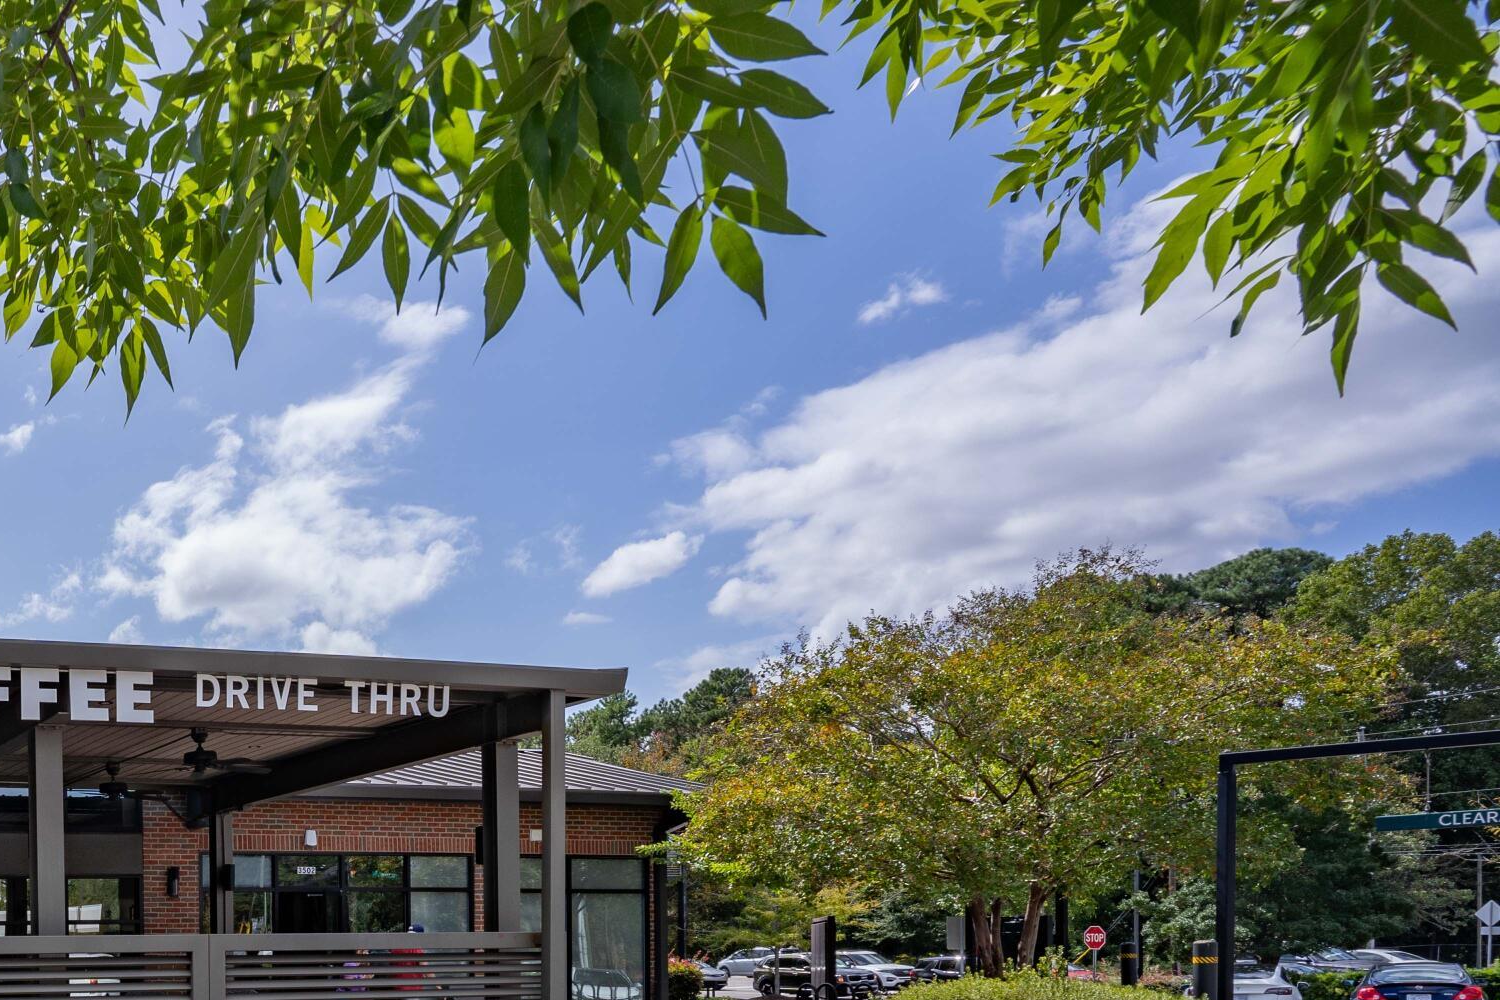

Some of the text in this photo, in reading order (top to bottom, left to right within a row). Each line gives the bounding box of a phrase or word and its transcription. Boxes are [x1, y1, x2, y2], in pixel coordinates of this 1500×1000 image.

[196, 673, 451, 718] DRIVE THRU
[1438, 811, 1500, 826] CLEAR
[1085, 933, 1104, 943] STOP
